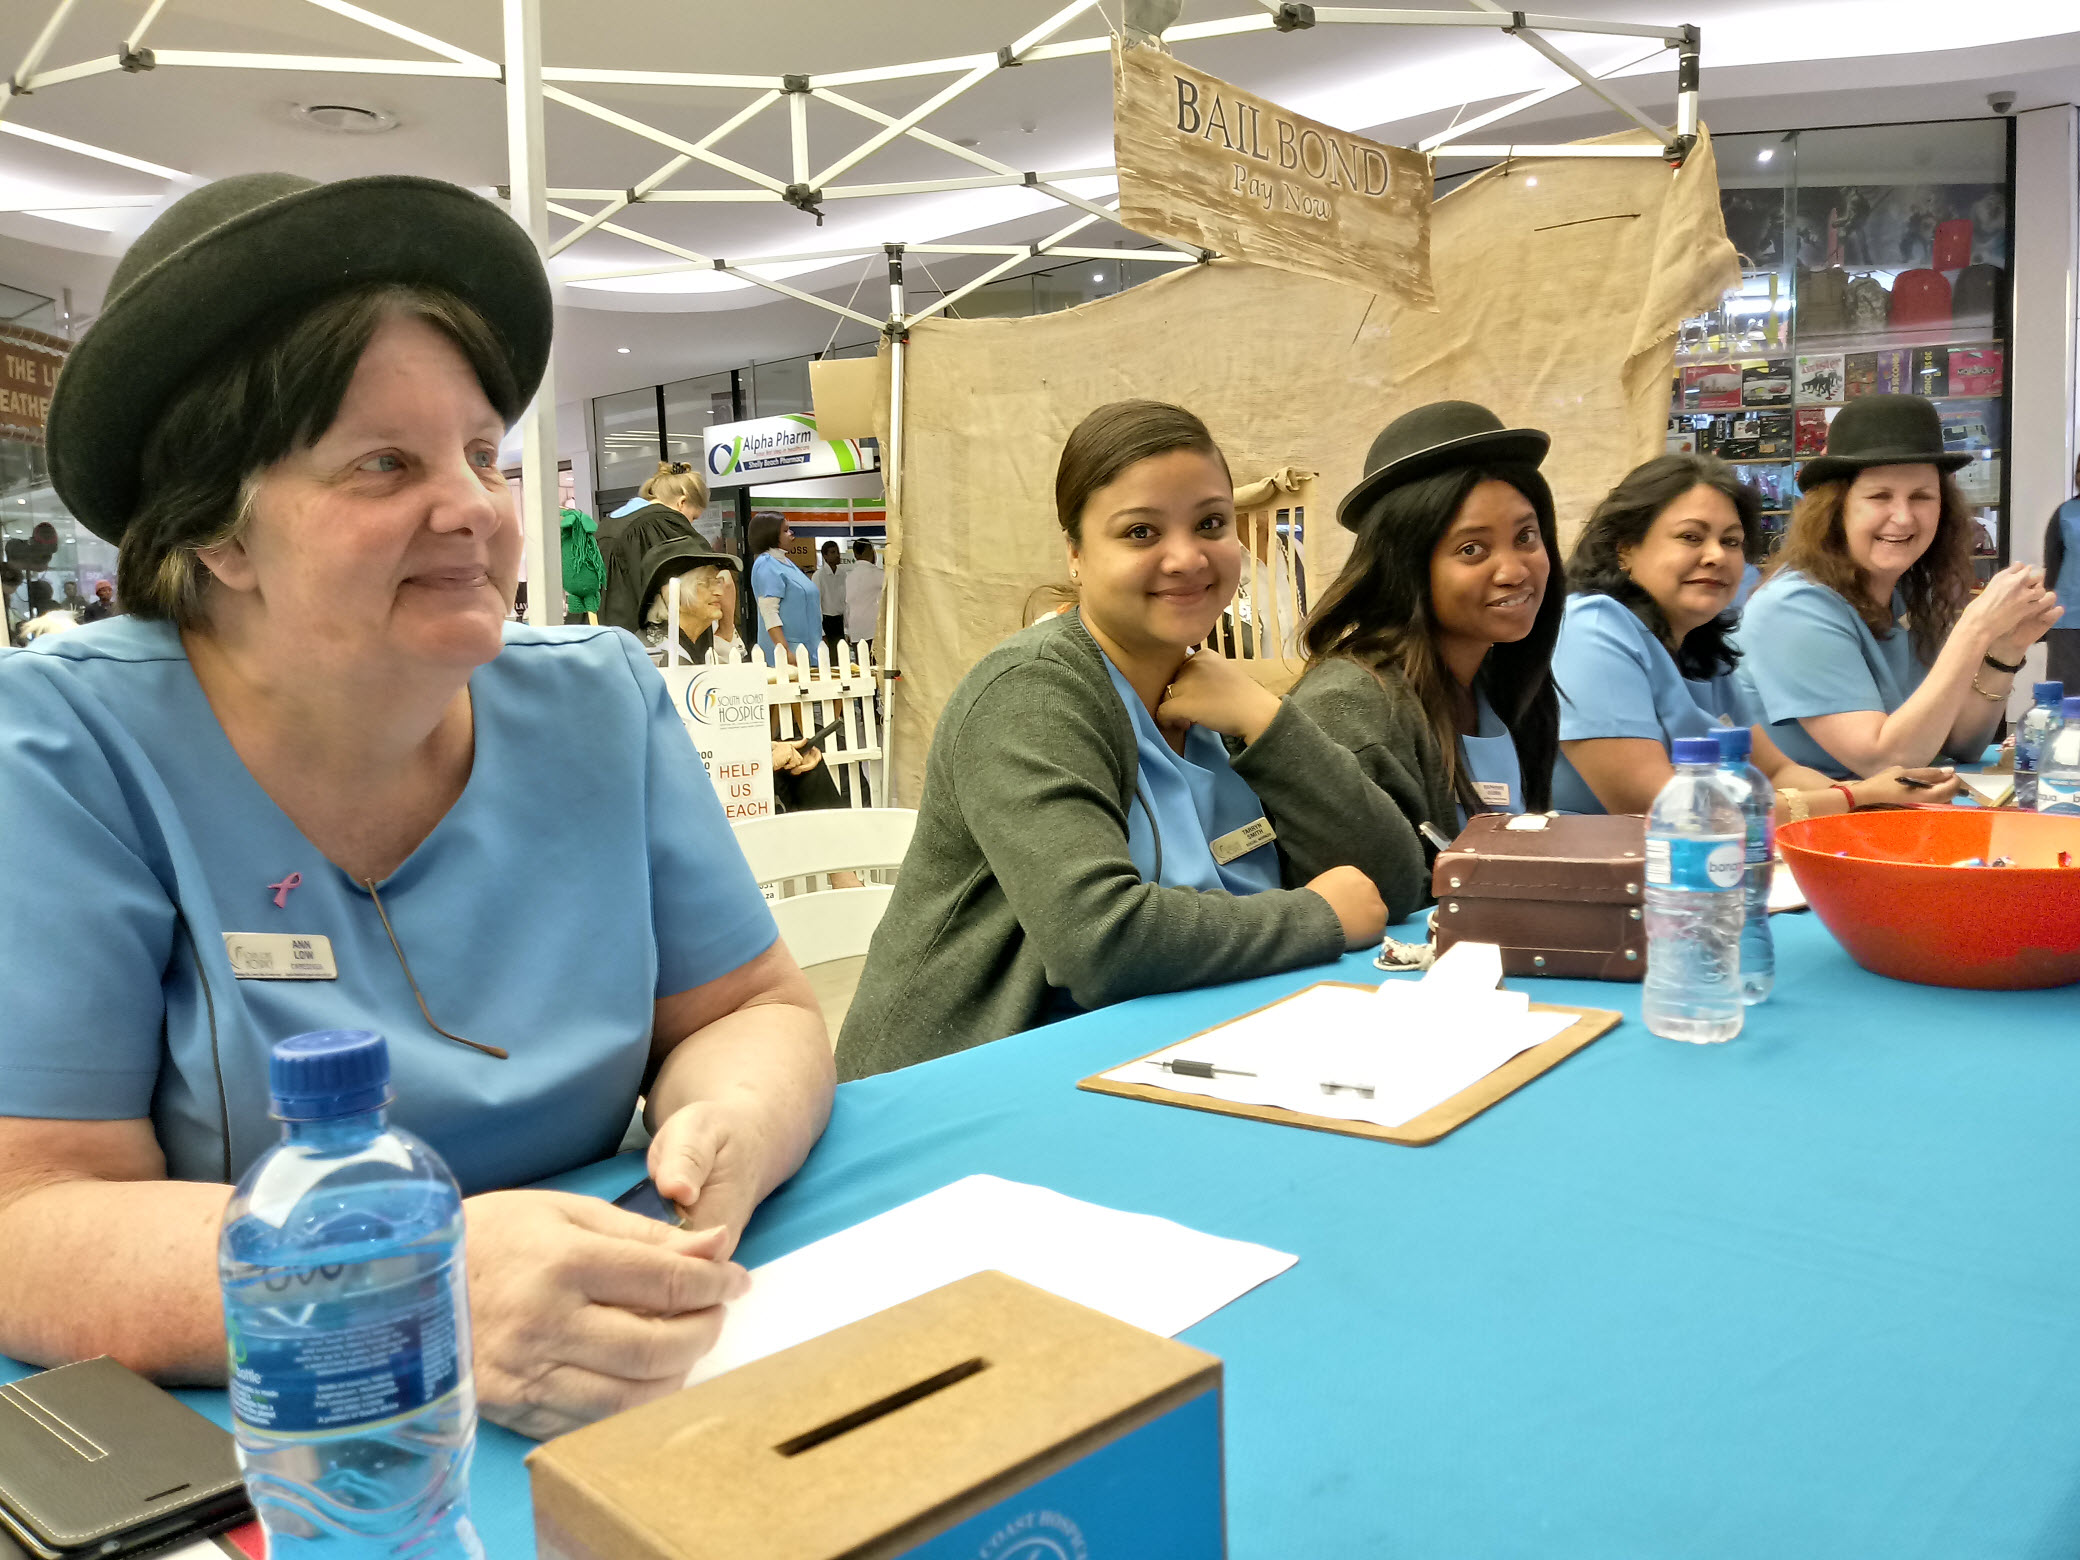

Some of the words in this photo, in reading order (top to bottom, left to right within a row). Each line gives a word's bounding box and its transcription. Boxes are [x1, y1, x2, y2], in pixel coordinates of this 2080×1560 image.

[1174, 75, 1270, 161] BAIL
[1276, 118, 1389, 196] BOND
[1233, 164, 1273, 210] Pay
[1283, 183, 1332, 220] Now
[6, 354, 37, 384] THE
[743, 433, 773, 454] Alpha
[776, 429, 811, 447] Pharm
[780, 455, 805, 464] Pharmacy
[718, 696, 740, 706] SOUTH
[743, 694, 764, 704] COAST
[719, 705, 765, 722] HOSPICE
[719, 762, 760, 779] HELP
[731, 783, 751, 798] US
[1242, 823, 1262, 835] TARRYN
[1246, 829, 1264, 839] SMITH
[292, 940, 312, 949] ANN
[293, 951, 314, 960] LOW
